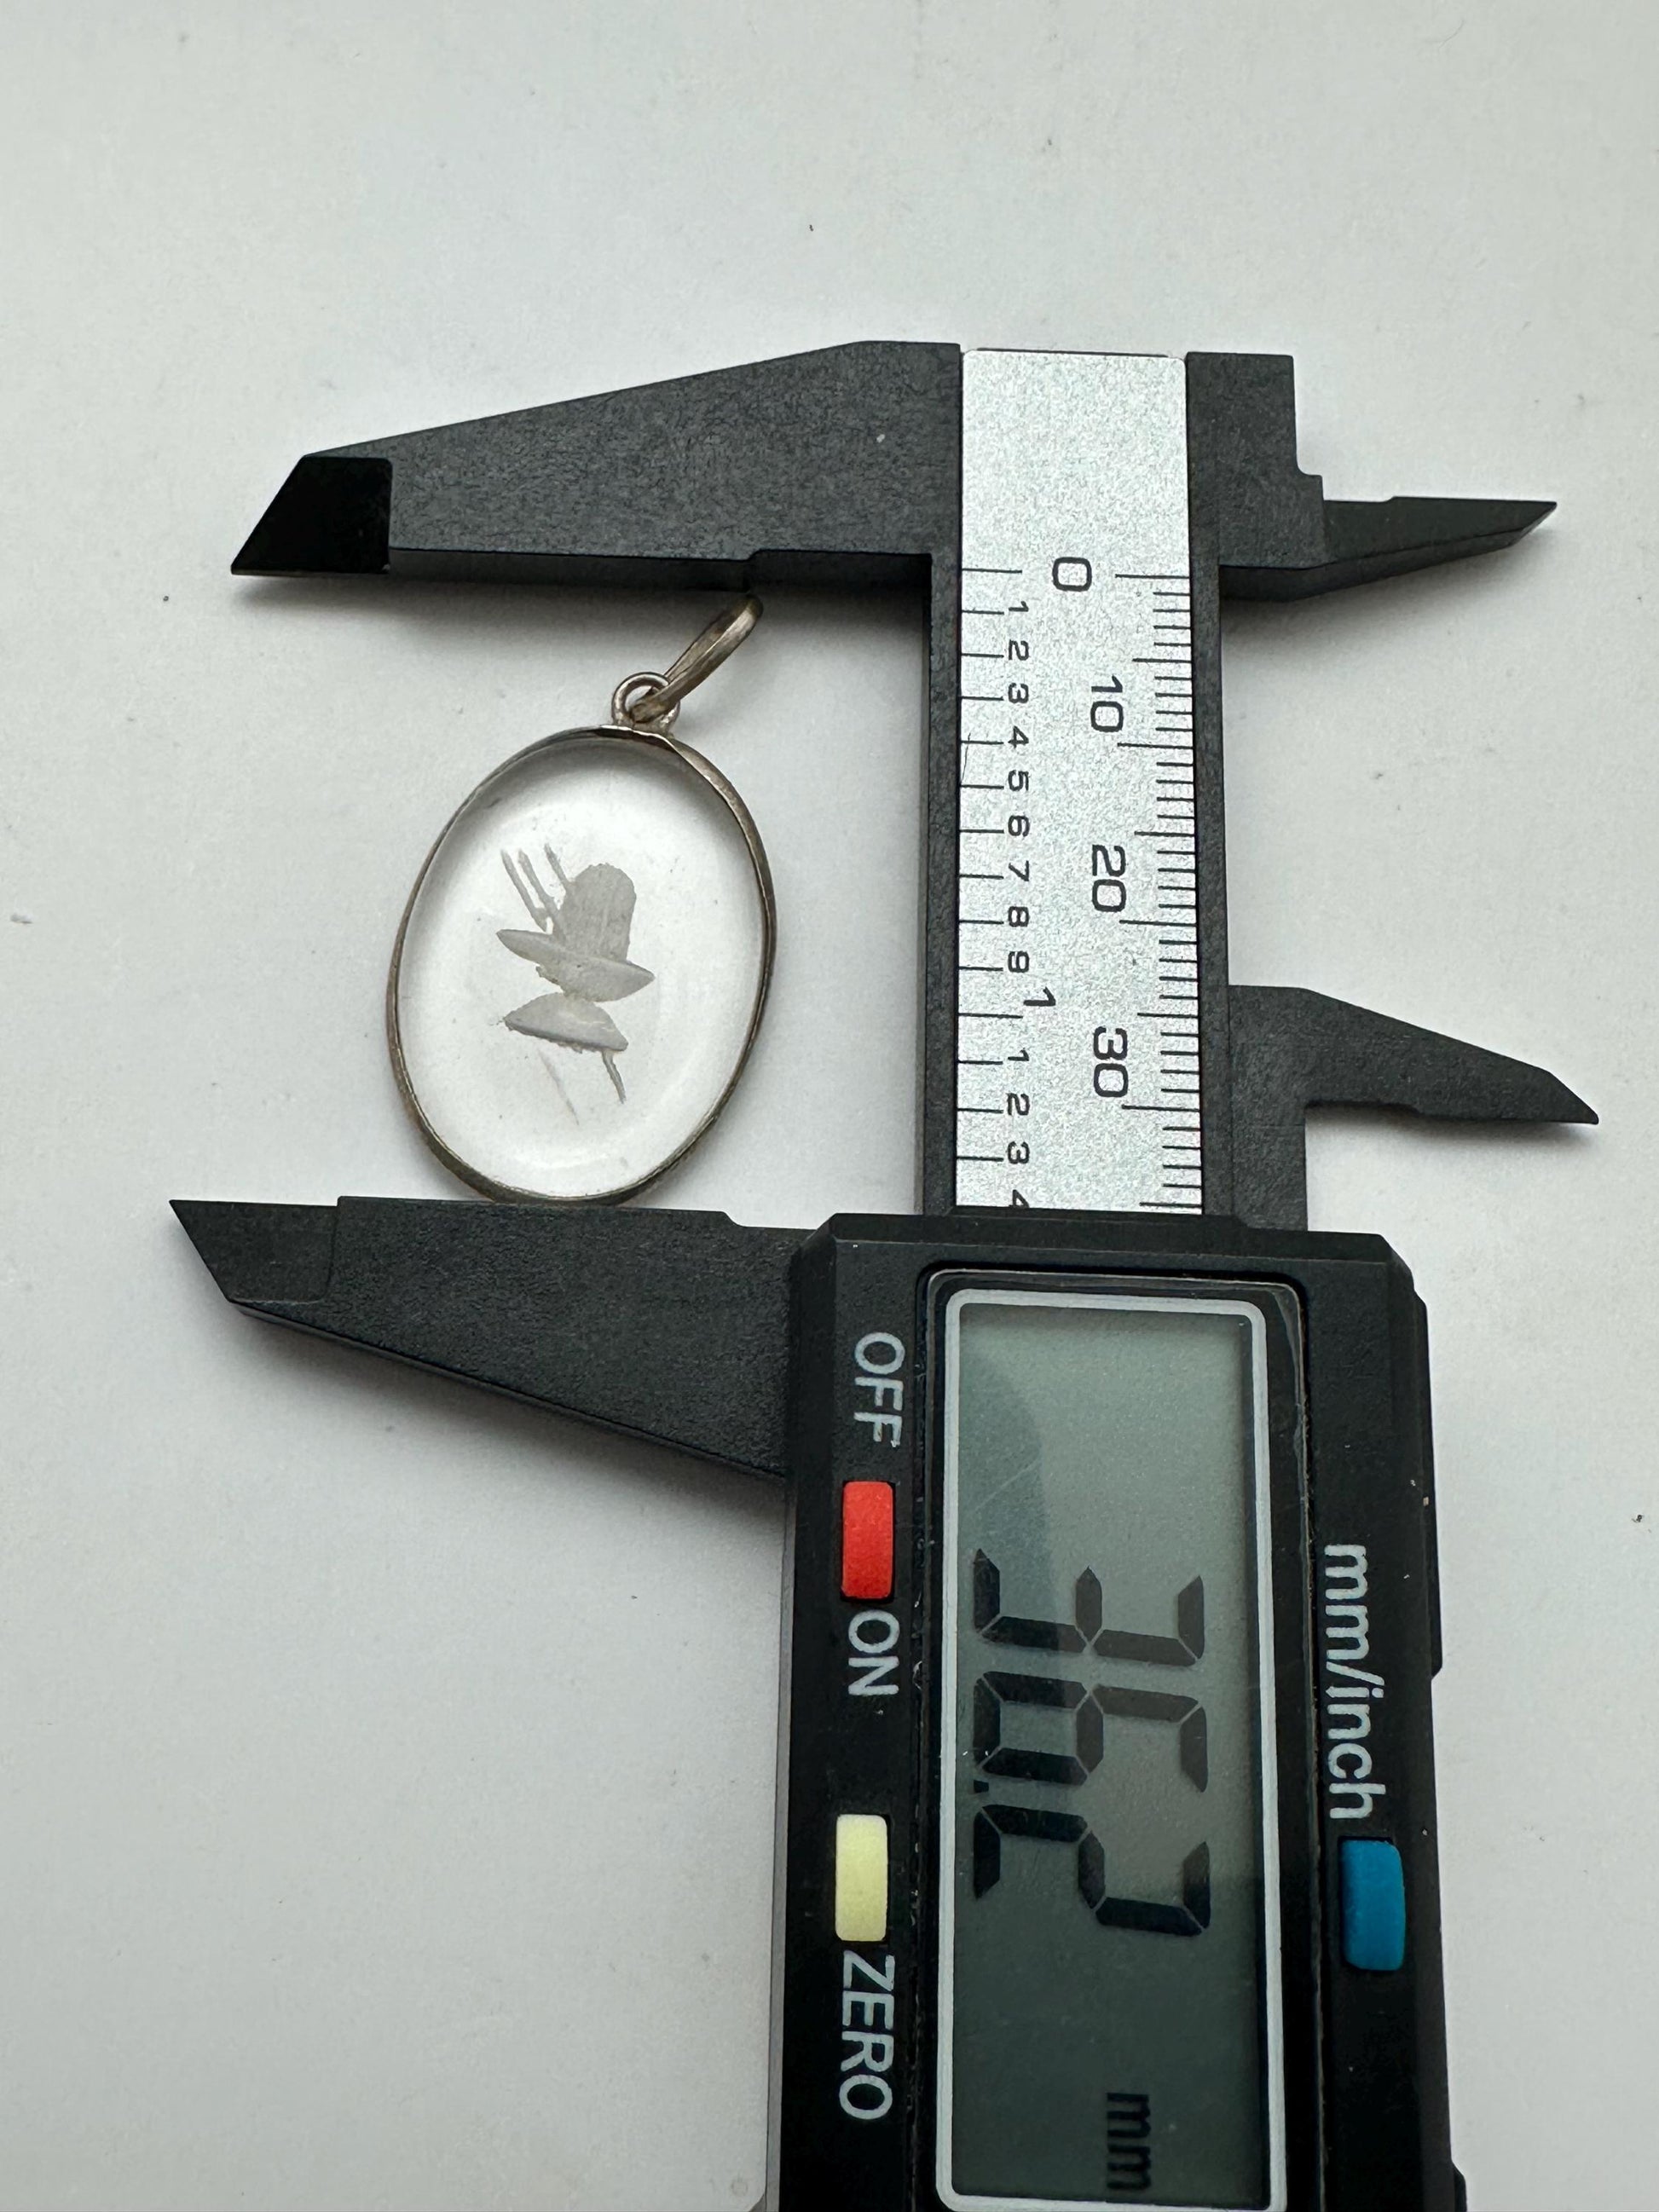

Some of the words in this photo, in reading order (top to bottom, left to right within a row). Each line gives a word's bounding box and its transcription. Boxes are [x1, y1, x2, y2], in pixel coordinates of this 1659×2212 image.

[1052, 557, 1092, 592] 0
[1008, 601, 1029, 612] 1
[1008, 639, 1029, 661] 2
[1008, 683, 1029, 704] 3
[1090, 675, 1124, 733] 10
[1008, 725, 1029, 748] 4
[1008, 770, 1029, 792] 5
[1008, 815, 1030, 837] 6
[1009, 860, 1030, 882] 7
[1091, 844, 1127, 913] 20
[1008, 906, 1030, 927] 8
[1008, 950, 1030, 973] 9
[1023, 987, 1056, 1007] 1
[1007, 1048, 1029, 1062] 1
[1093, 1026, 1129, 1098] 30
[1007, 1093, 1030, 1116] 2
[1007, 1141, 1030, 1164] 3
[855, 1331, 905, 1447] OFF
[848, 1611, 899, 1696] ON
[1324, 1544, 1386, 1819] mm/inch
[973, 1548, 1211, 1938] 36.2
[1107, 2093, 1151, 2189] mm
[841, 1953, 895, 2120] ZERO
